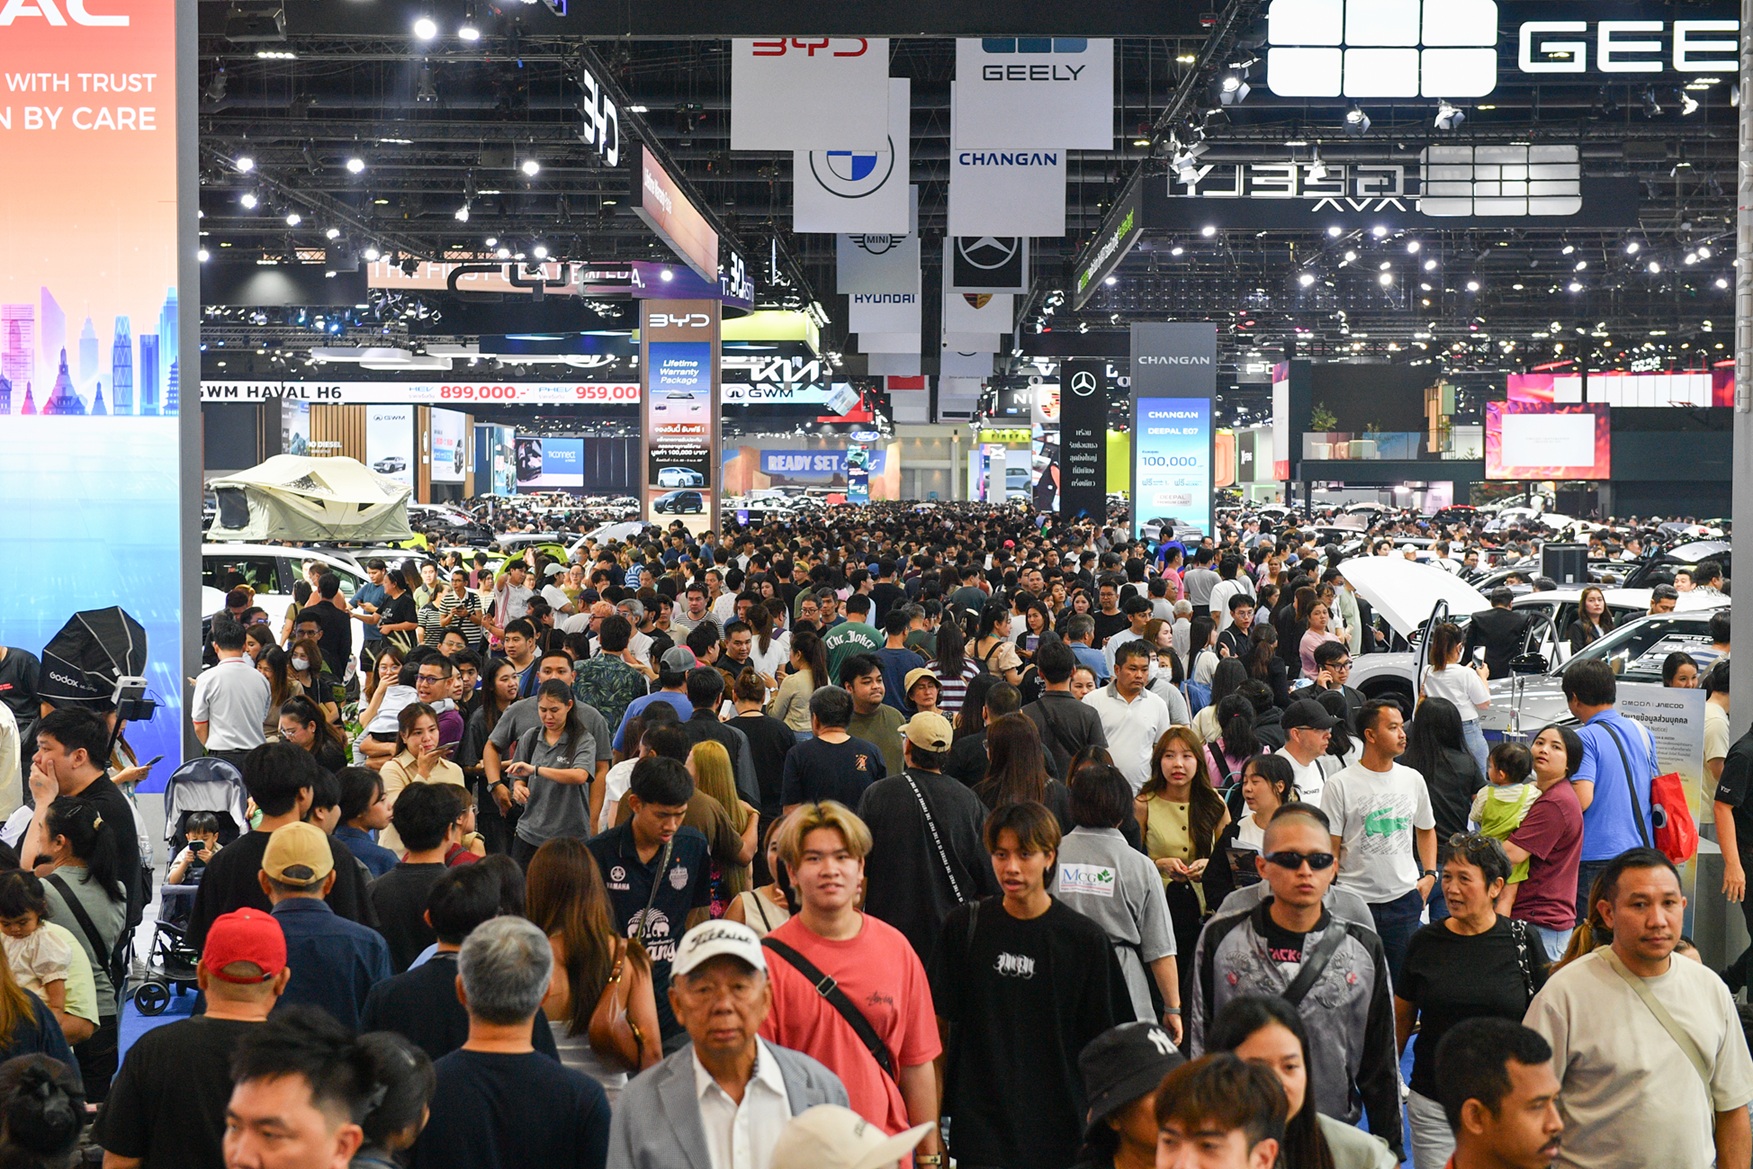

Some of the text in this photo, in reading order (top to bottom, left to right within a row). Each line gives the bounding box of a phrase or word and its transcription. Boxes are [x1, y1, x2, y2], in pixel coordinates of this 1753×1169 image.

[983, 65, 1086, 81] GEELY
[5, 73, 157, 93] WITH TRUST
[24, 106, 64, 130] BY
[72, 107, 157, 131] CARE
[959, 153, 1057, 166] CHANGAN
[866, 236, 889, 244] MINI
[854, 294, 915, 304] HYUNDAI
[649, 313, 710, 328] BYD
[662, 359, 699, 367] Lifetime
[1138, 356, 1210, 365] CHANGAN
[660, 368, 700, 377] Warranty
[660, 376, 698, 386] Package
[200, 385, 343, 399] WM HAVAL H6
[576, 385, 640, 400] 959,00
[748, 388, 793, 398] GWM
[1148, 411, 1199, 419] CHANGAN
[1147, 427, 1199, 435] DEEPAL E07
[767, 455, 812, 471] READY
[813, 455, 839, 471] SET
[1142, 456, 1197, 467] 100,000
[825, 629, 876, 650] The Joker
[49, 671, 79, 688] Godox
[606, 881, 630, 891] YAMAHA
